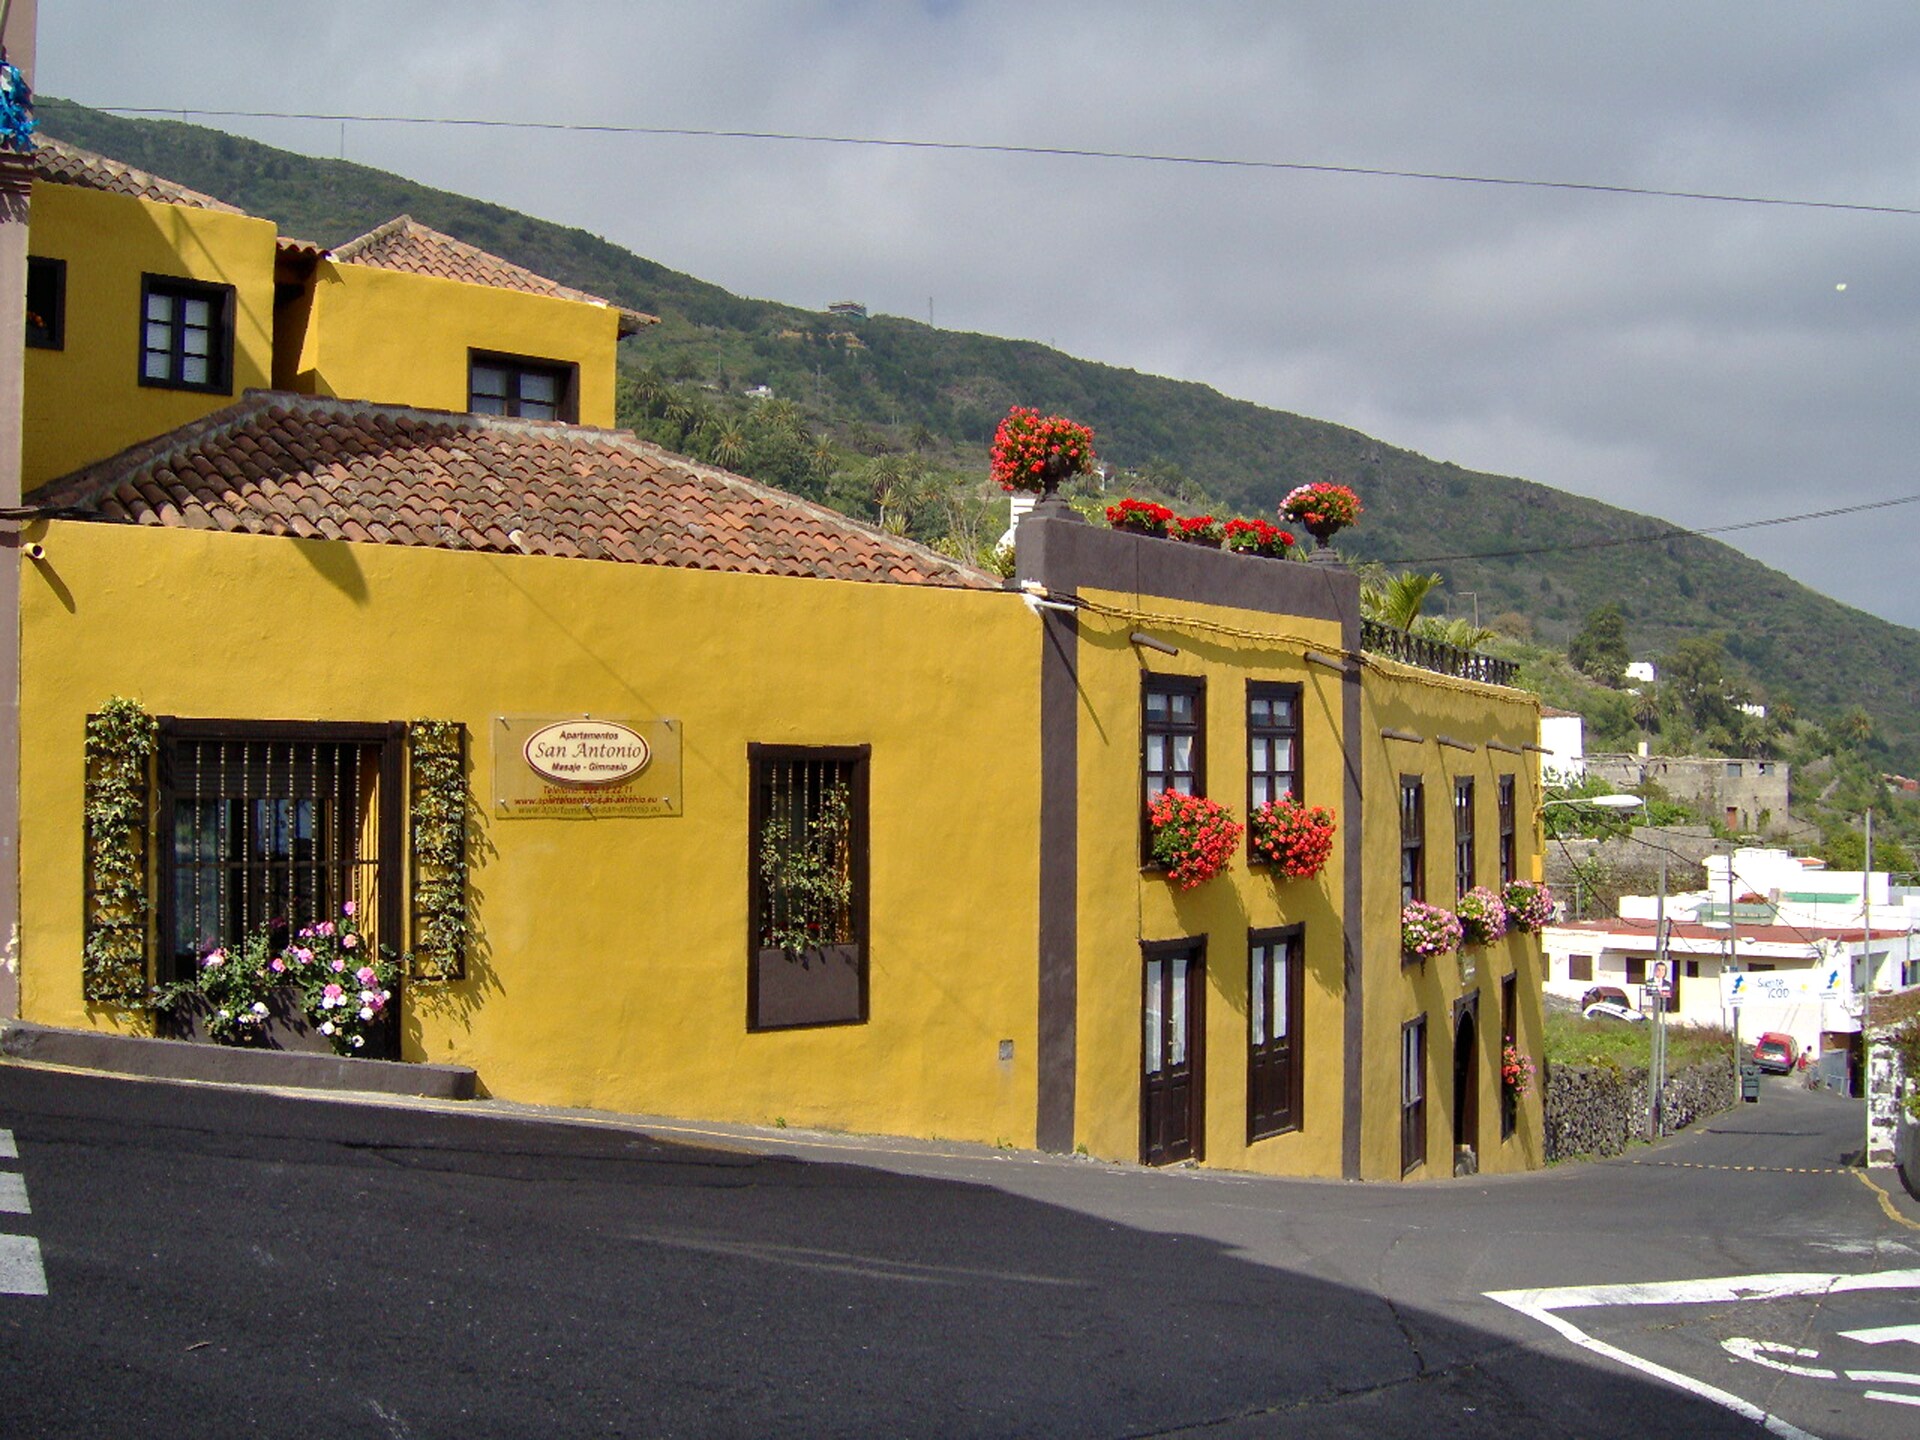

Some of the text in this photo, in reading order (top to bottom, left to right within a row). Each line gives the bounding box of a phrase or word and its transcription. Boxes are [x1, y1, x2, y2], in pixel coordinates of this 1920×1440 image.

[535, 742, 641, 758] San Antonio
[552, 762, 581, 773] Masaje
[589, 762, 628, 772] Gimnasio
